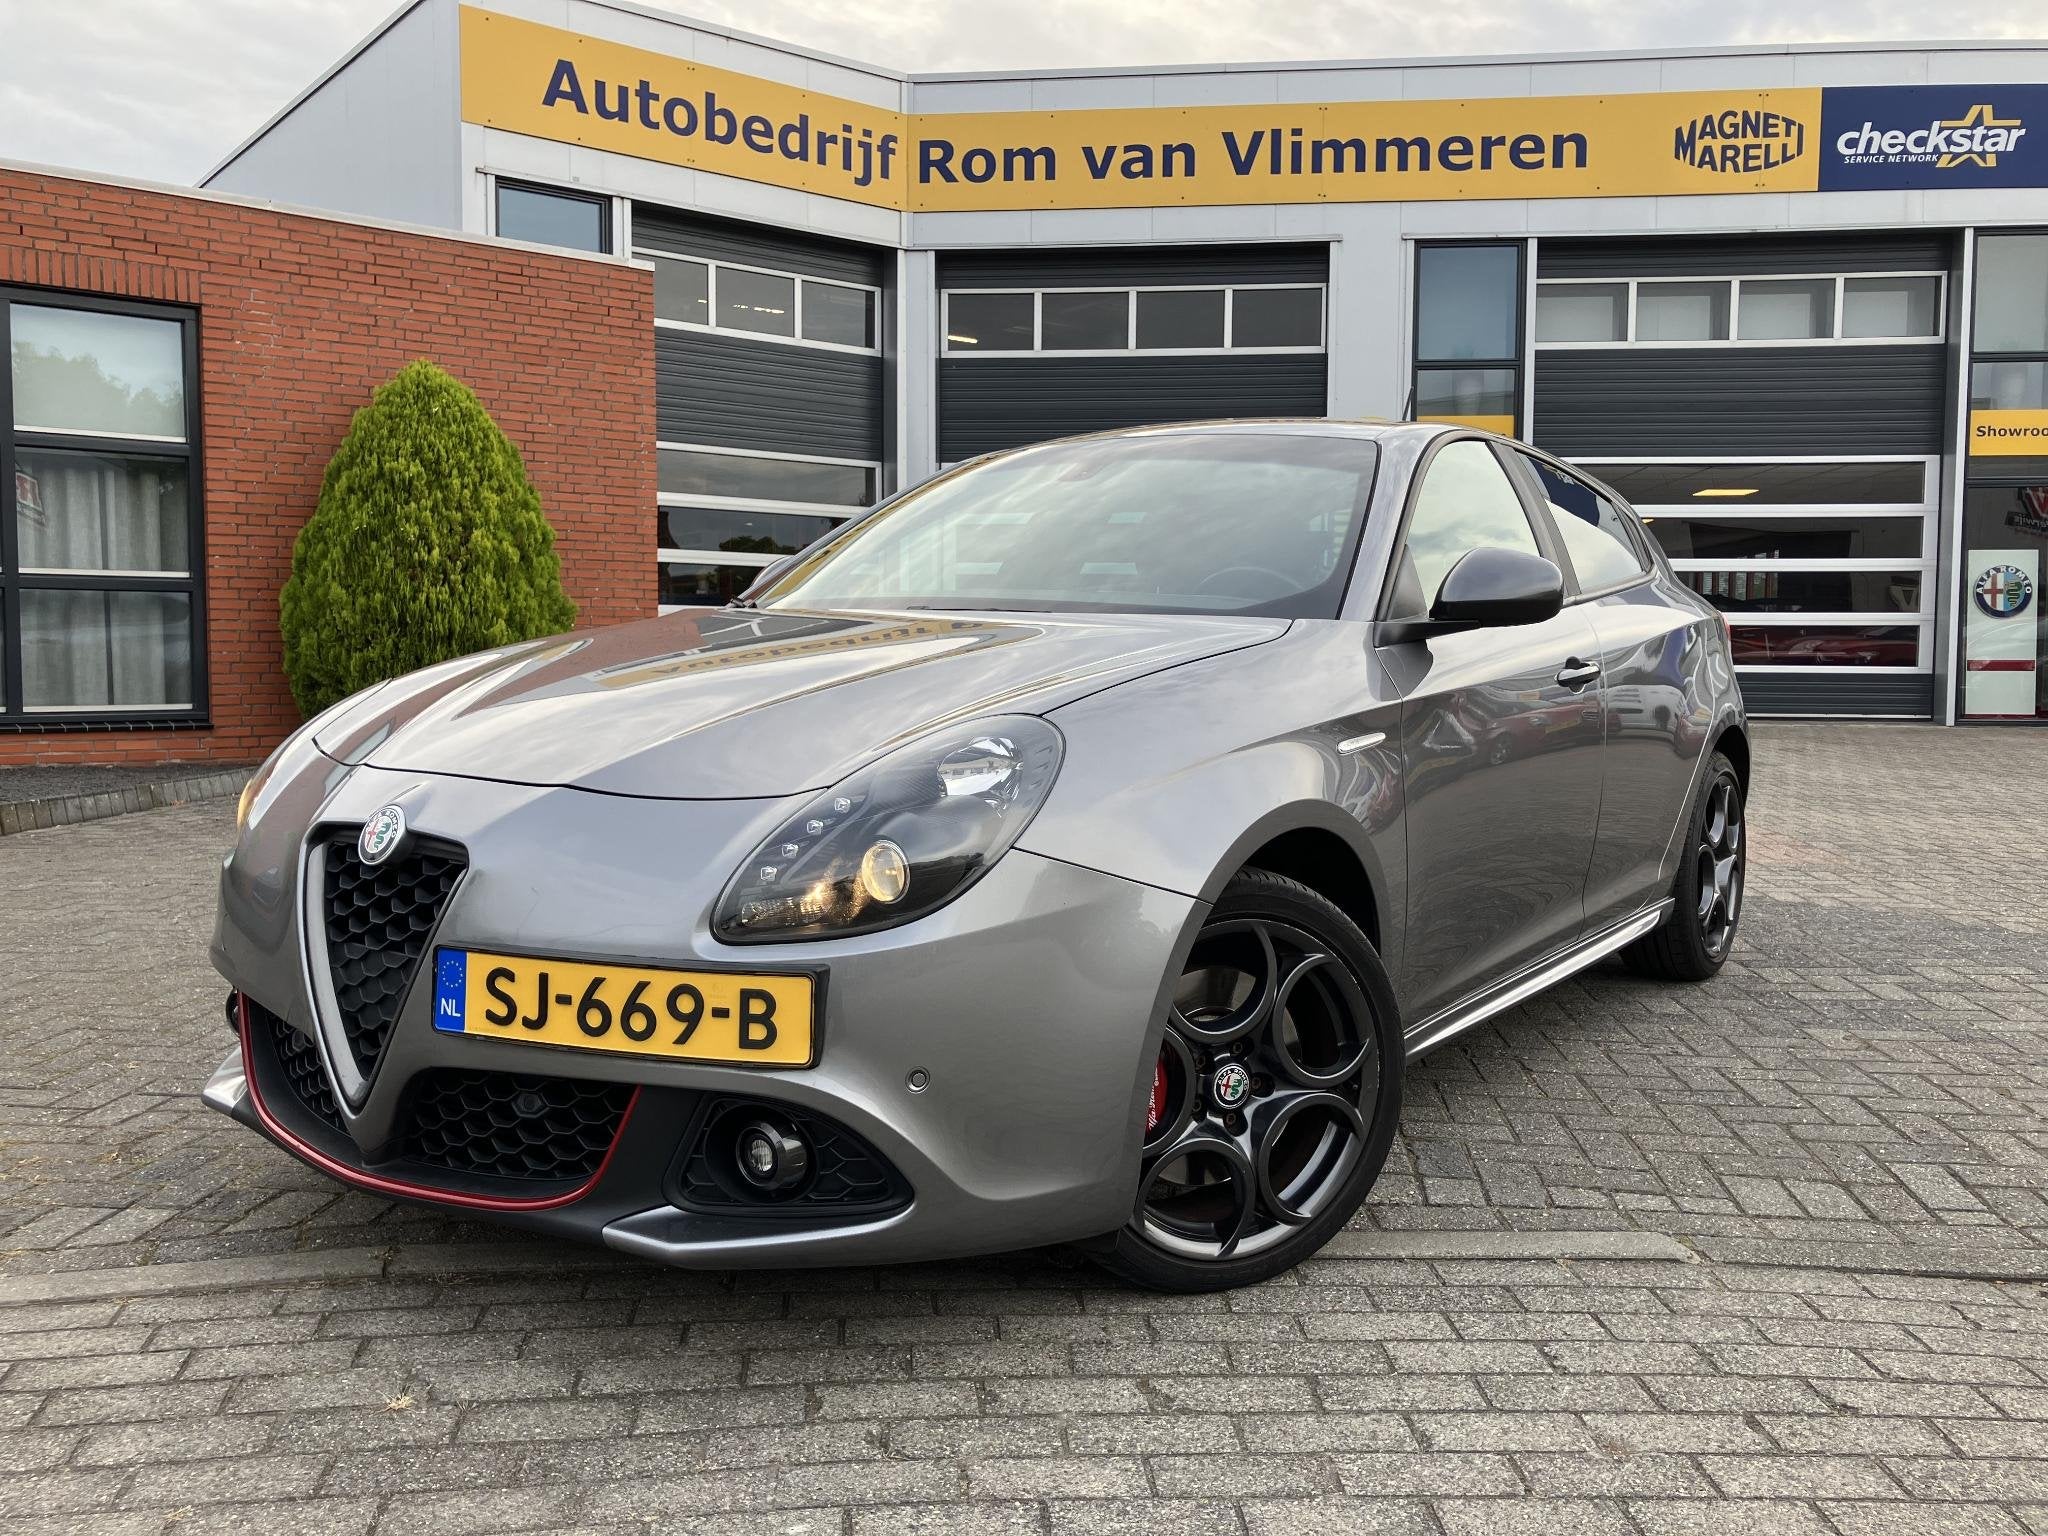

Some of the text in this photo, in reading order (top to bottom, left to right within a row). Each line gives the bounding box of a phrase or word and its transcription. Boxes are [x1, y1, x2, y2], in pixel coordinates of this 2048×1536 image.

[542, 58, 1588, 186] Autobedrijf Rom van Vlimmeren
[1674, 110, 1804, 148] MAGNETI
[1836, 120, 2026, 155] checkstar
[1674, 134, 1804, 173] MARELLI
[1844, 153, 1939, 164] SERVICE NETWORK
[1976, 565, 2032, 594] ALFA ROMEO
[440, 966, 778, 1050] NL SJ-669-B
